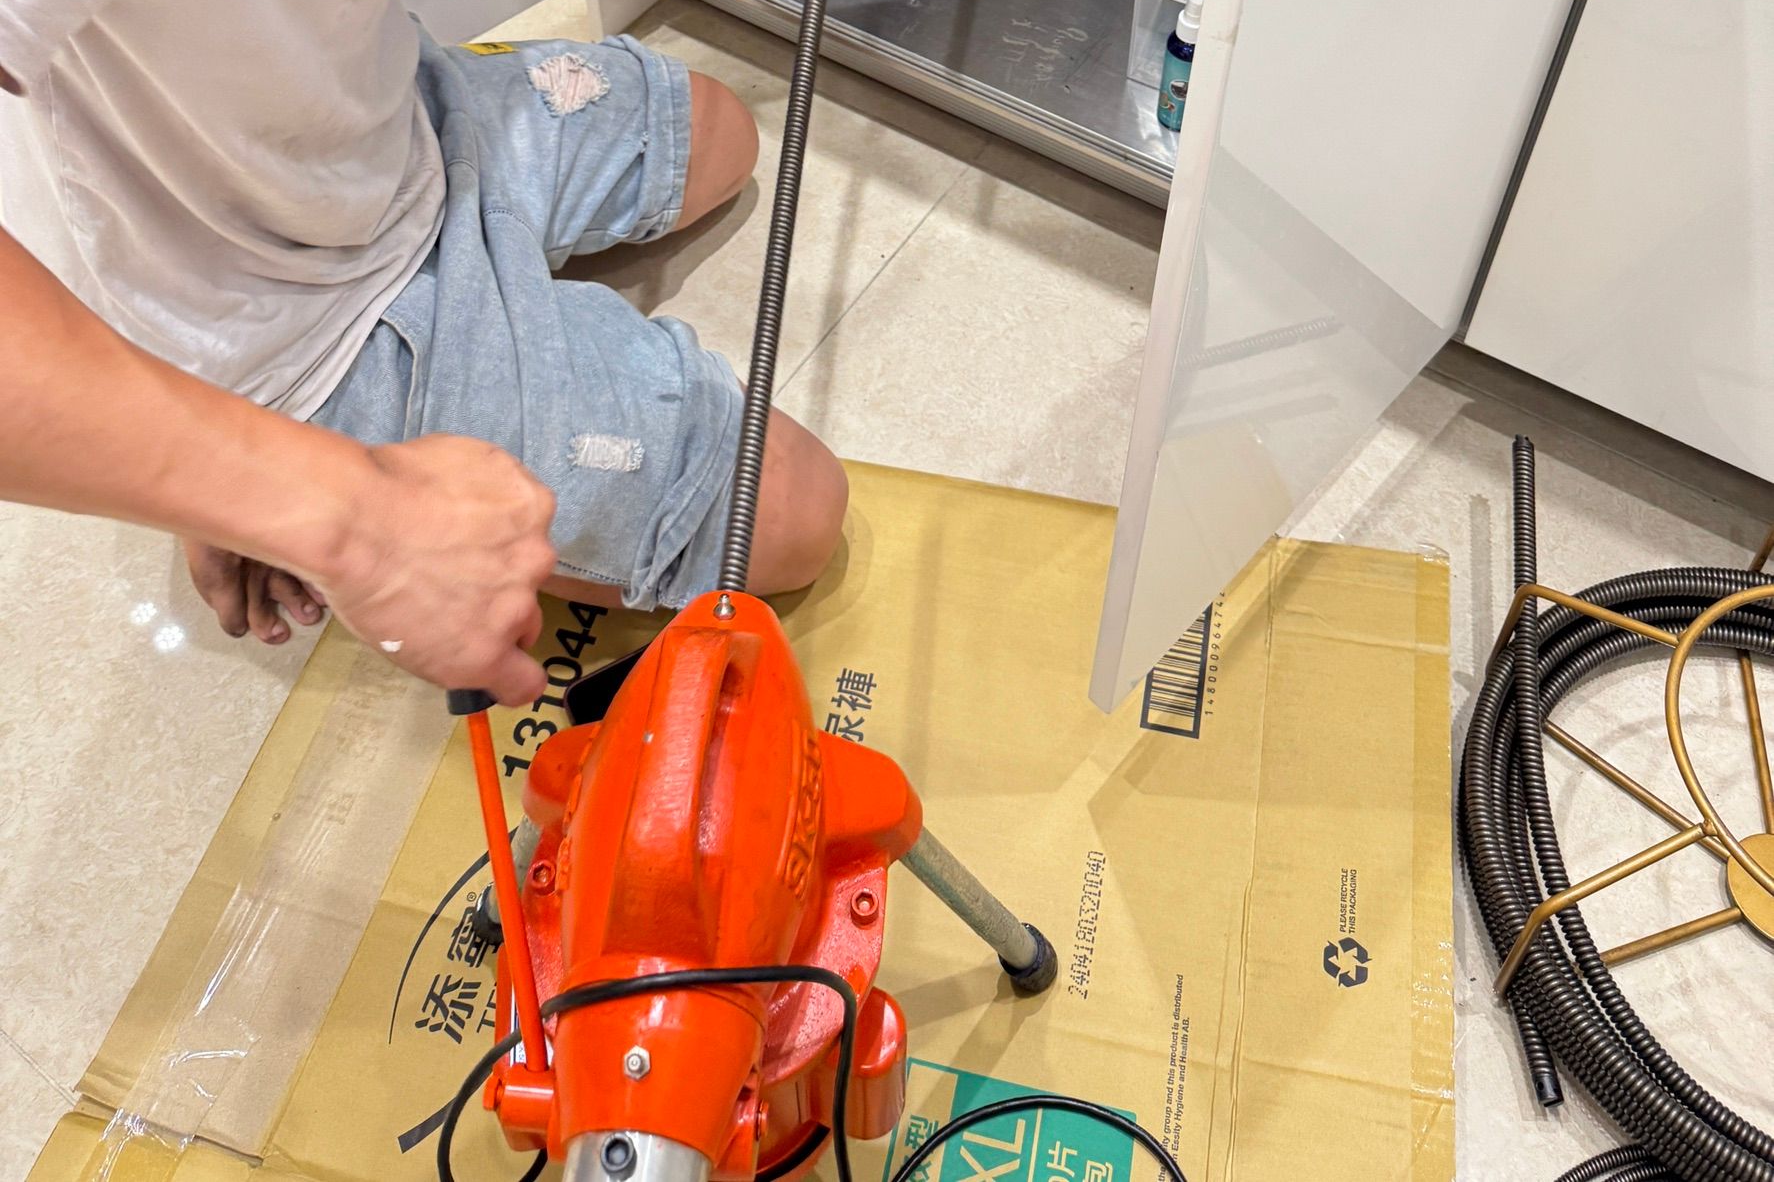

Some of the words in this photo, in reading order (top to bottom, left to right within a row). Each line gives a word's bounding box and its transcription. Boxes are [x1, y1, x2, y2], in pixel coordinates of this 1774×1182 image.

[502, 601, 608, 777] 131044
[1340, 868, 1348, 903] RECYCLE
[1349, 869, 1357, 915] PACKAGING
[1339, 903, 1347, 933] PLEASE
[1172, 974, 1184, 1020] distributed
[1171, 1022, 1179, 1030] is
[1181, 1017, 1190, 1033] AB.
[1169, 1031, 1180, 1067] product
[1179, 1034, 1188, 1063] Health
[1167, 1068, 1176, 1085] this
[1177, 1065, 1186, 1082] and
[1165, 1088, 1174, 1104] and
[1174, 1084, 1185, 1121] Hygiene
[1163, 1106, 1173, 1134] group
[1171, 1122, 1182, 1151] Essity
